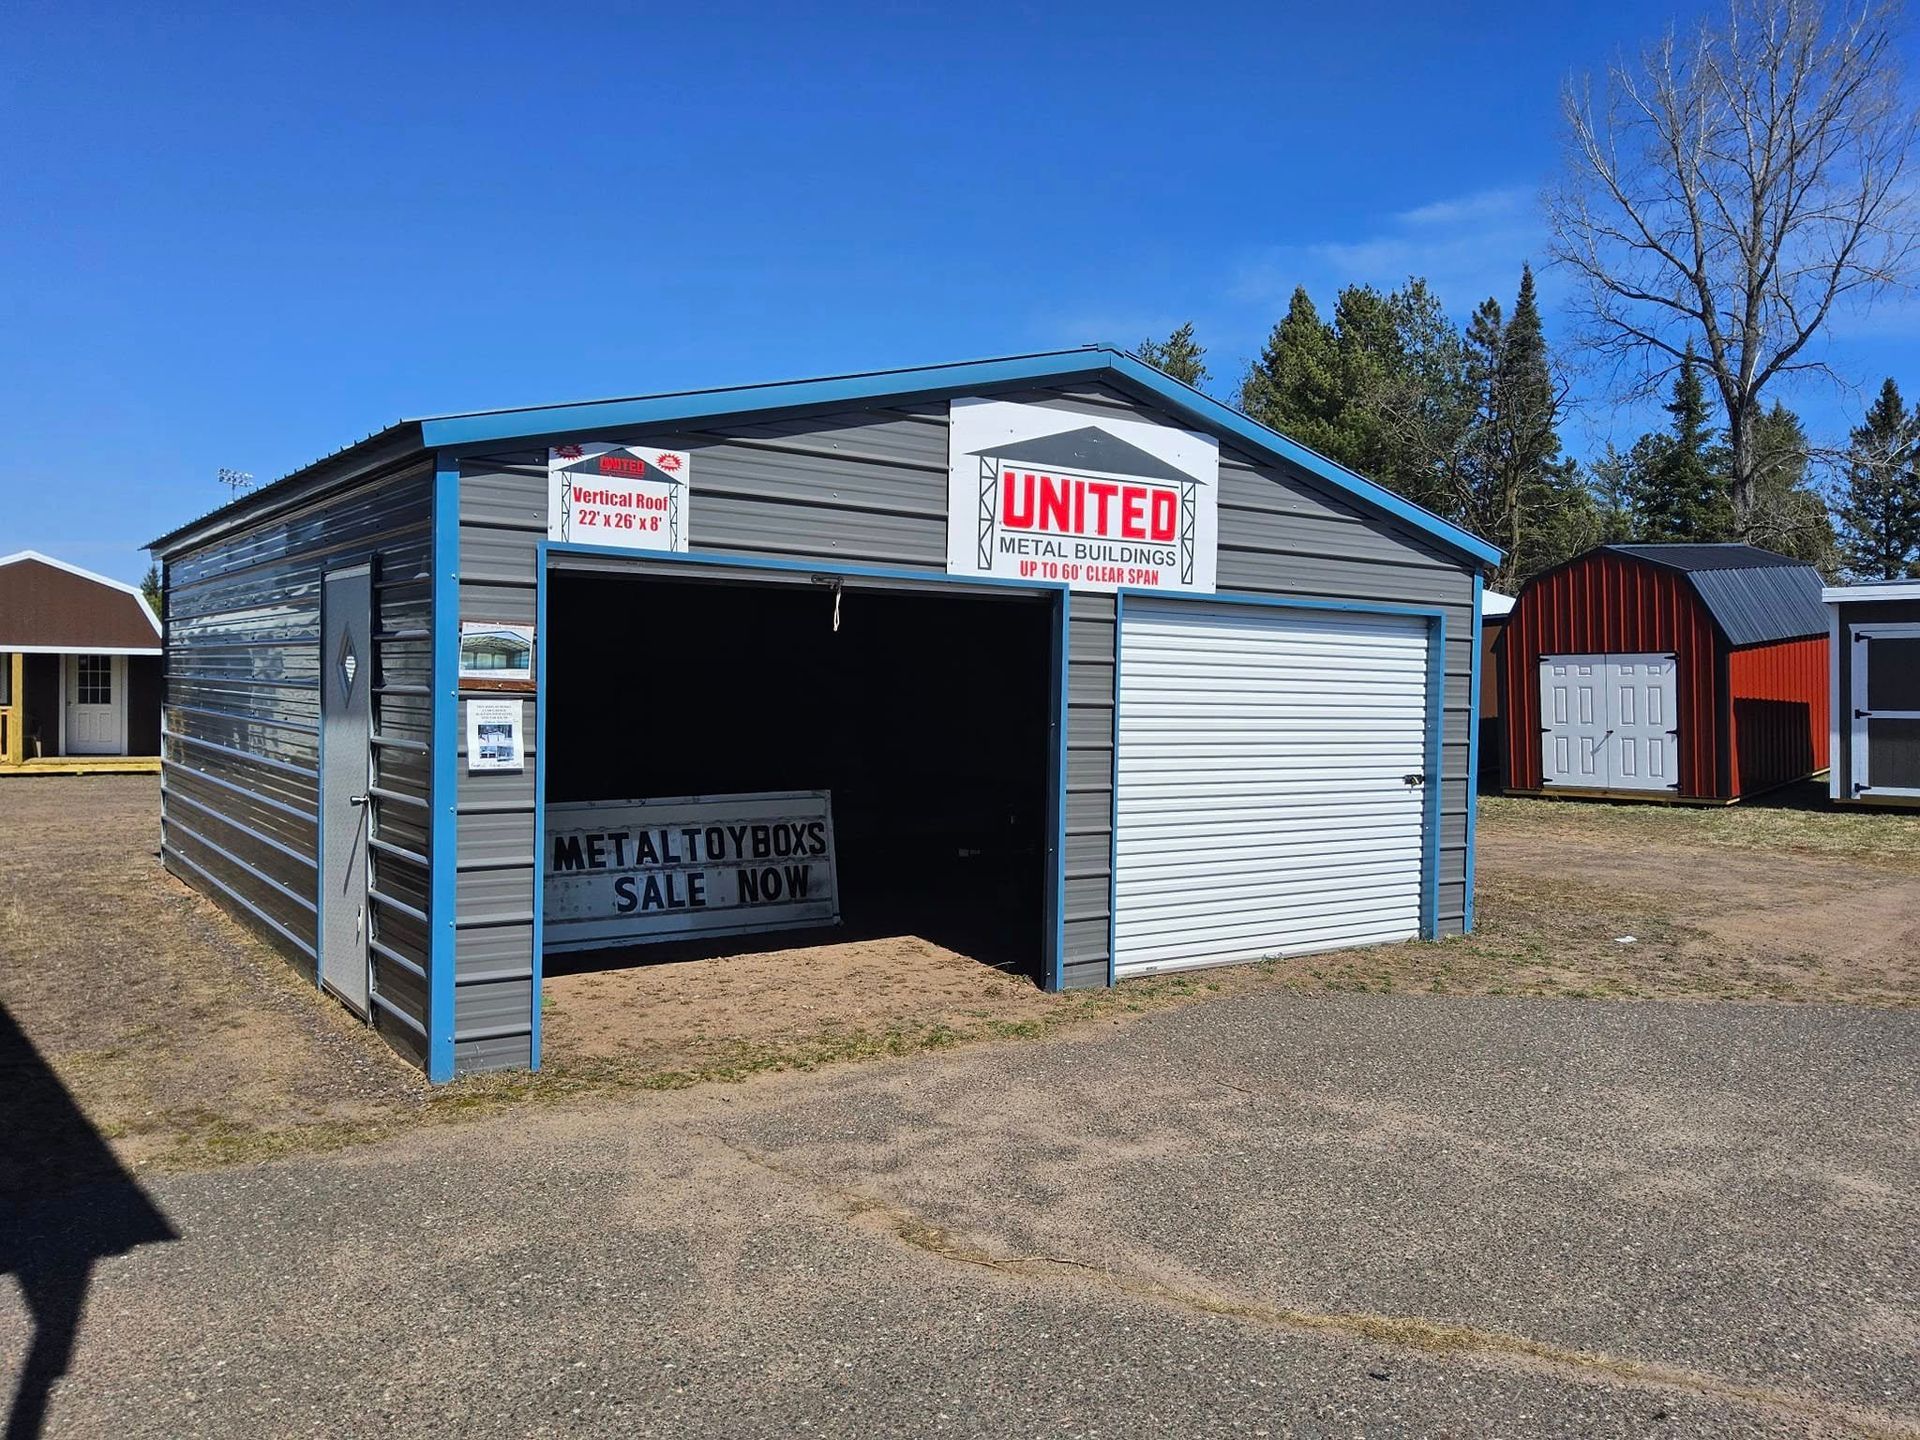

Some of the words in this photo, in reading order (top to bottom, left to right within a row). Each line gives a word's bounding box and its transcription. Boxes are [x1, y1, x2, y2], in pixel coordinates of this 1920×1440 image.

[600, 456, 645, 474] UNITED
[573, 487, 633, 508] Vertical
[636, 493, 668, 511] Roof
[1003, 472, 1178, 542] UNITED
[579, 509, 600, 526] 22'
[604, 515, 611, 528] x
[615, 512, 636, 529] 26'
[640, 518, 647, 530] x
[650, 516, 662, 532] 8'
[1000, 537, 1068, 559] METAL
[1075, 543, 1176, 567] BUILDINGS
[1020, 561, 1039, 578] UP
[1042, 563, 1060, 579] TO
[1062, 564, 1083, 580] 60'
[1086, 566, 1124, 583] CLEAR
[1128, 569, 1159, 585] SPAN
[614, 872, 706, 912] SALE
[738, 865, 809, 903] NOW
